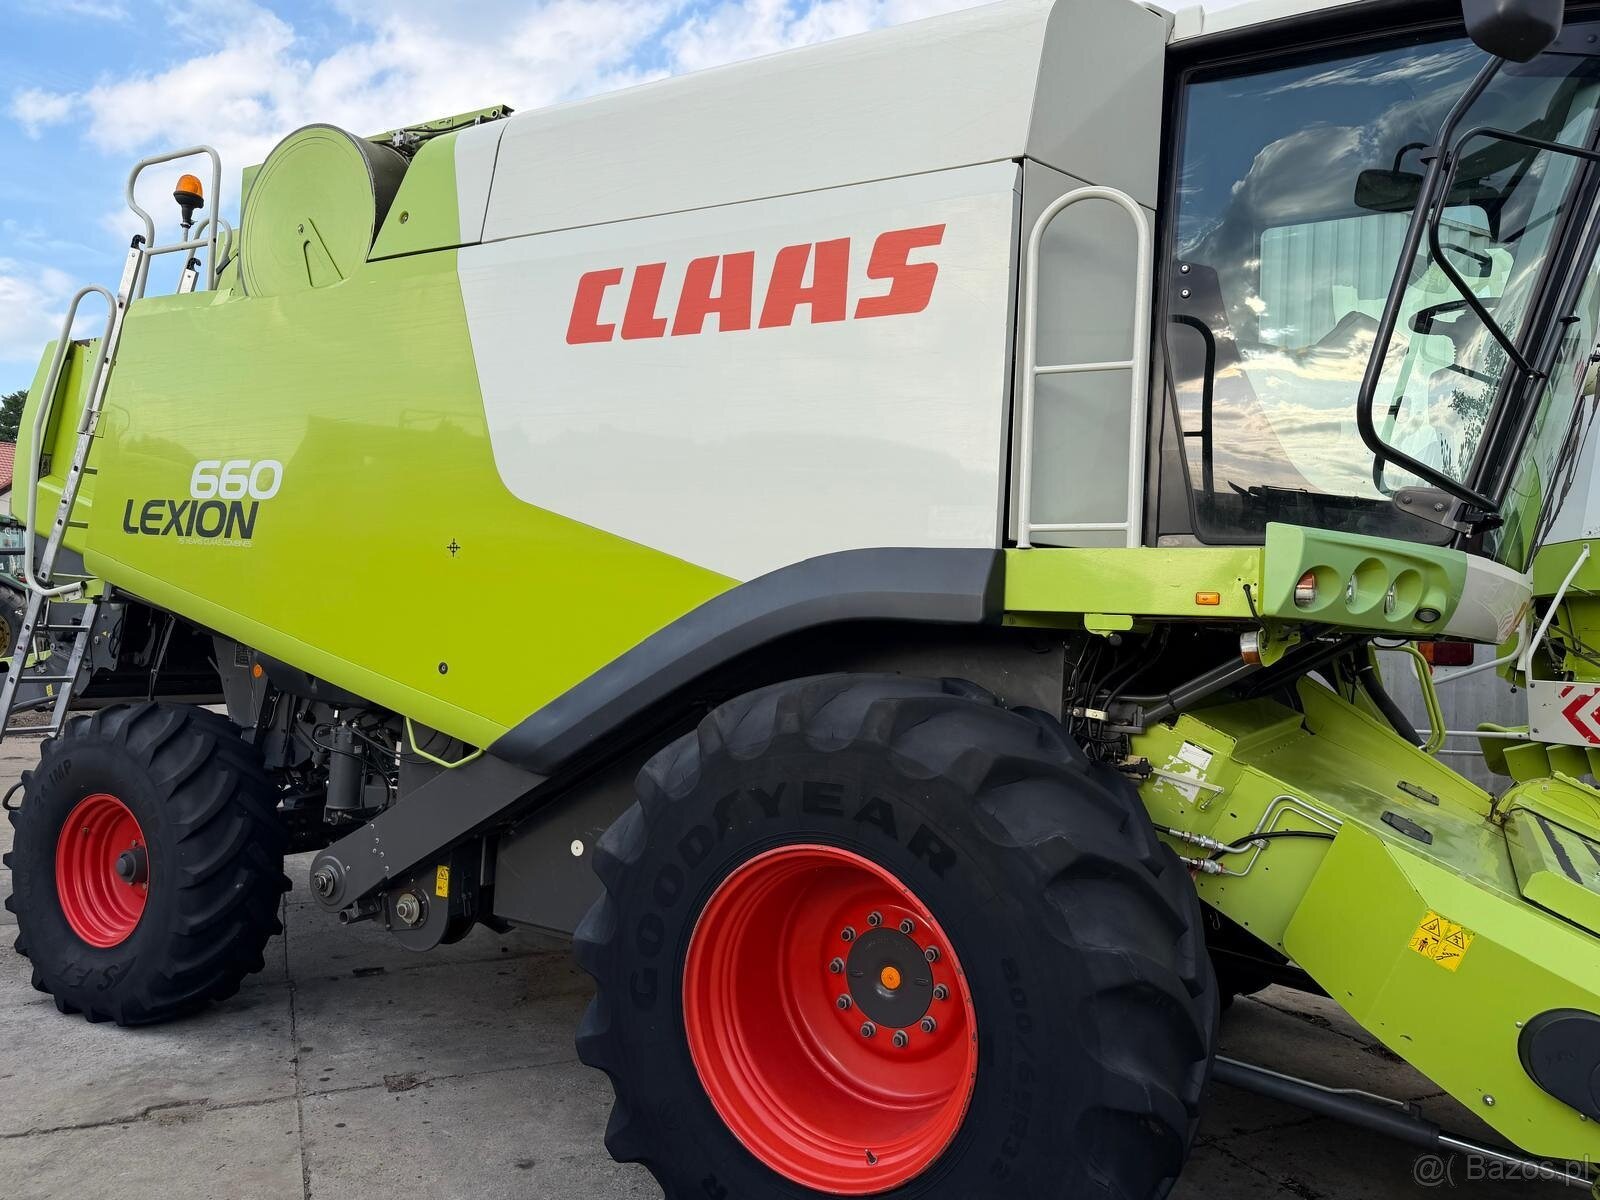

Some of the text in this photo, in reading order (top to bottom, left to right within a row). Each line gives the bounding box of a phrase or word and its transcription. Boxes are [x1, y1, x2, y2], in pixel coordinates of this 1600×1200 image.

[566, 223, 947, 345] CLAAS
[189, 459, 283, 500] 660
[122, 498, 260, 540] LEXION
[48, 758, 73, 787] IMP
[629, 779, 958, 1011] GOODYEAR
